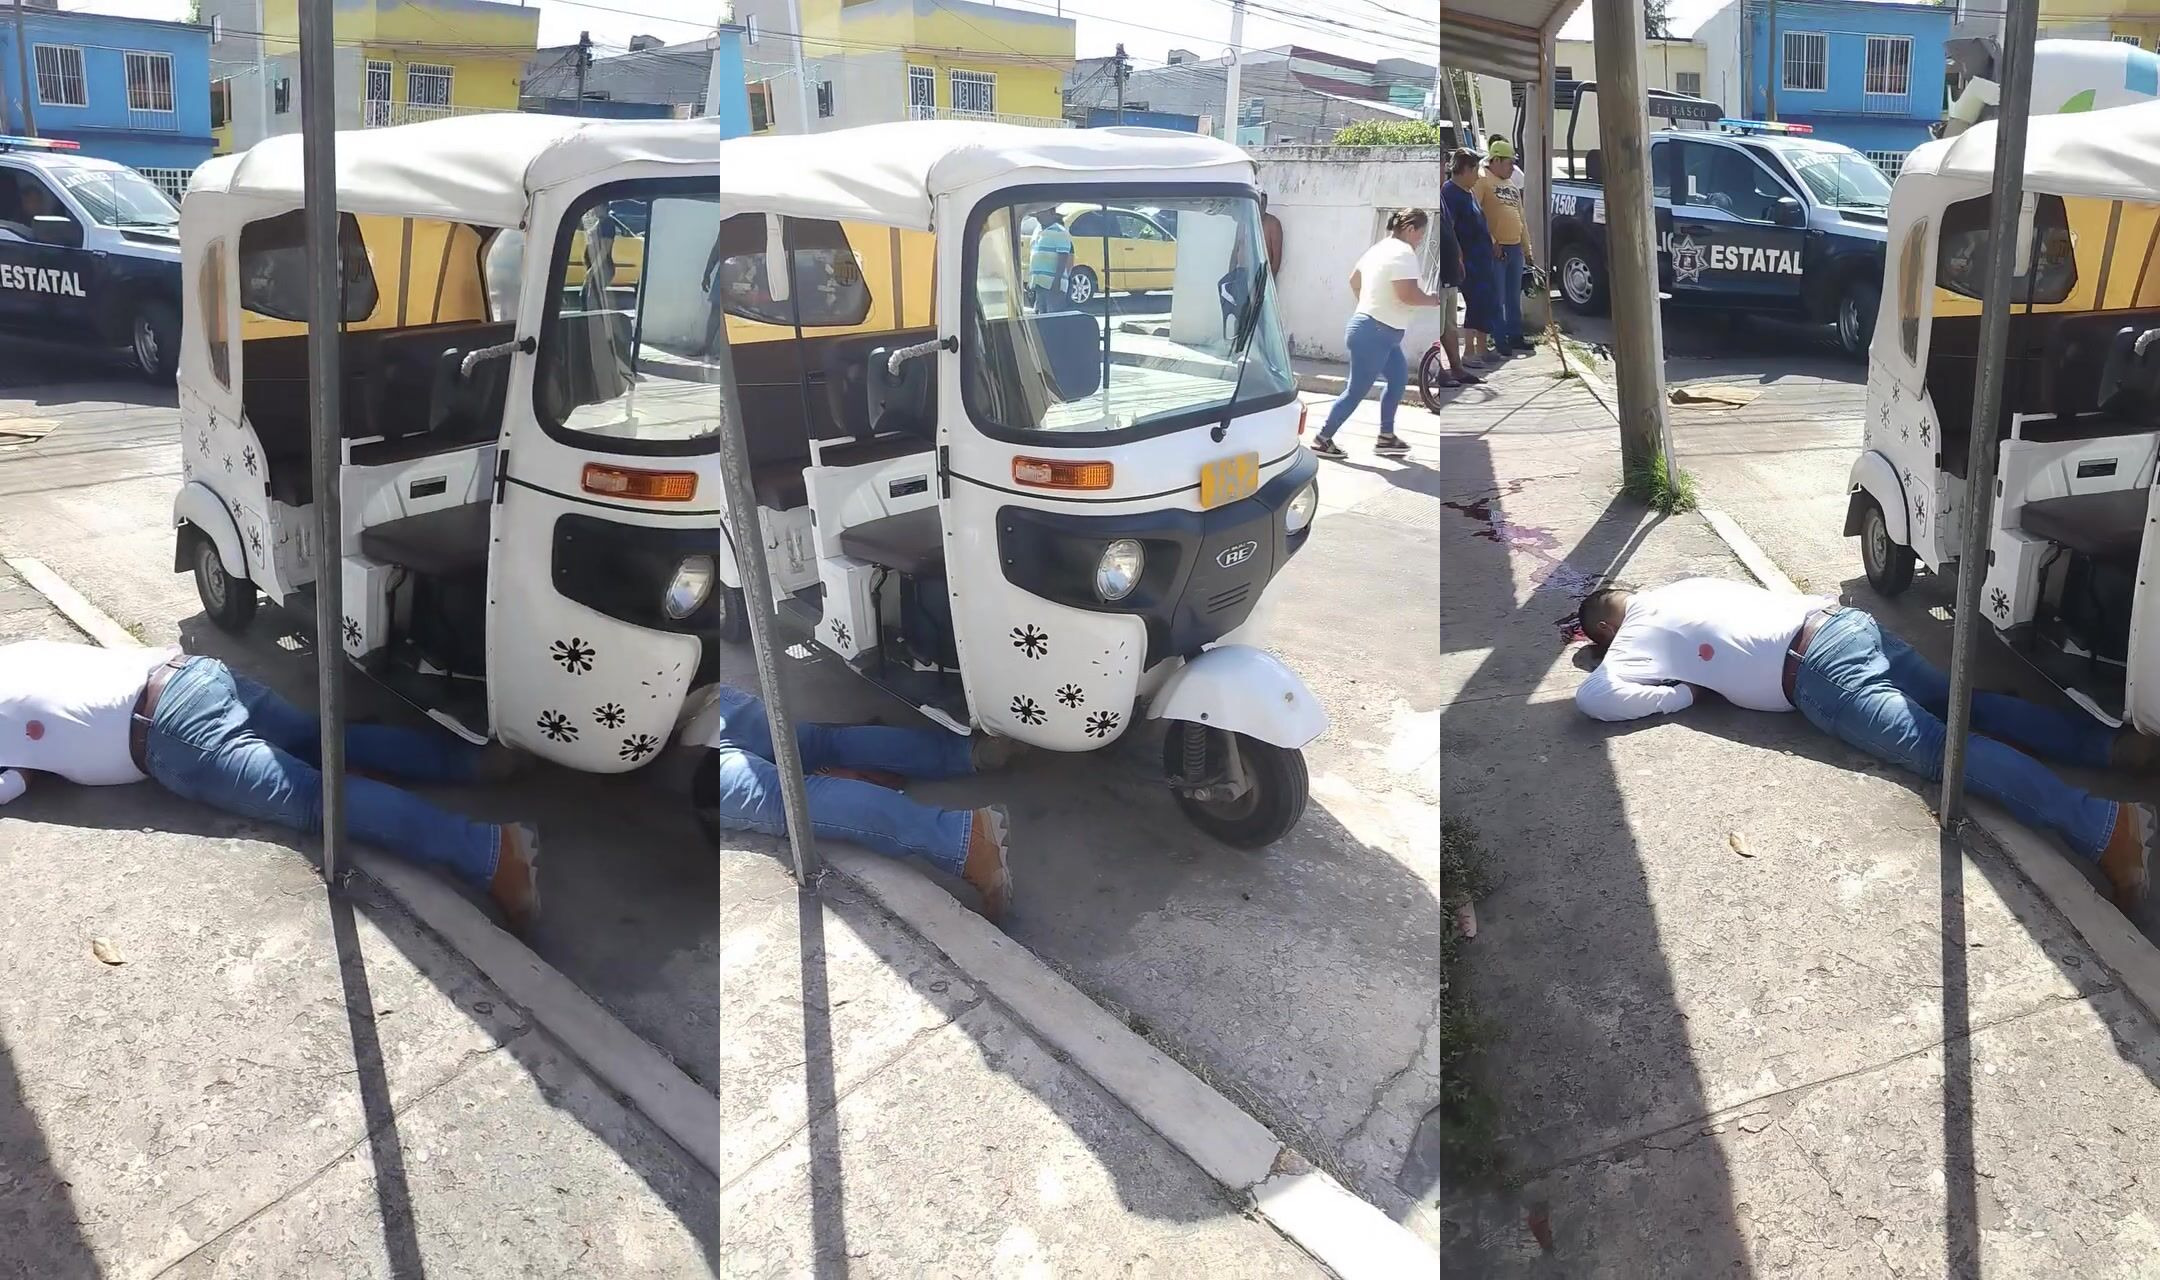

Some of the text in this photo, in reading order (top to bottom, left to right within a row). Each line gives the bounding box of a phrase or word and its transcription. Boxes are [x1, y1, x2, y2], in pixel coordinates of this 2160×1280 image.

[1711, 244, 1804, 275] ESTATAL
[0, 263, 86, 297] ESTATAL
[1225, 547, 1249, 565] RE
